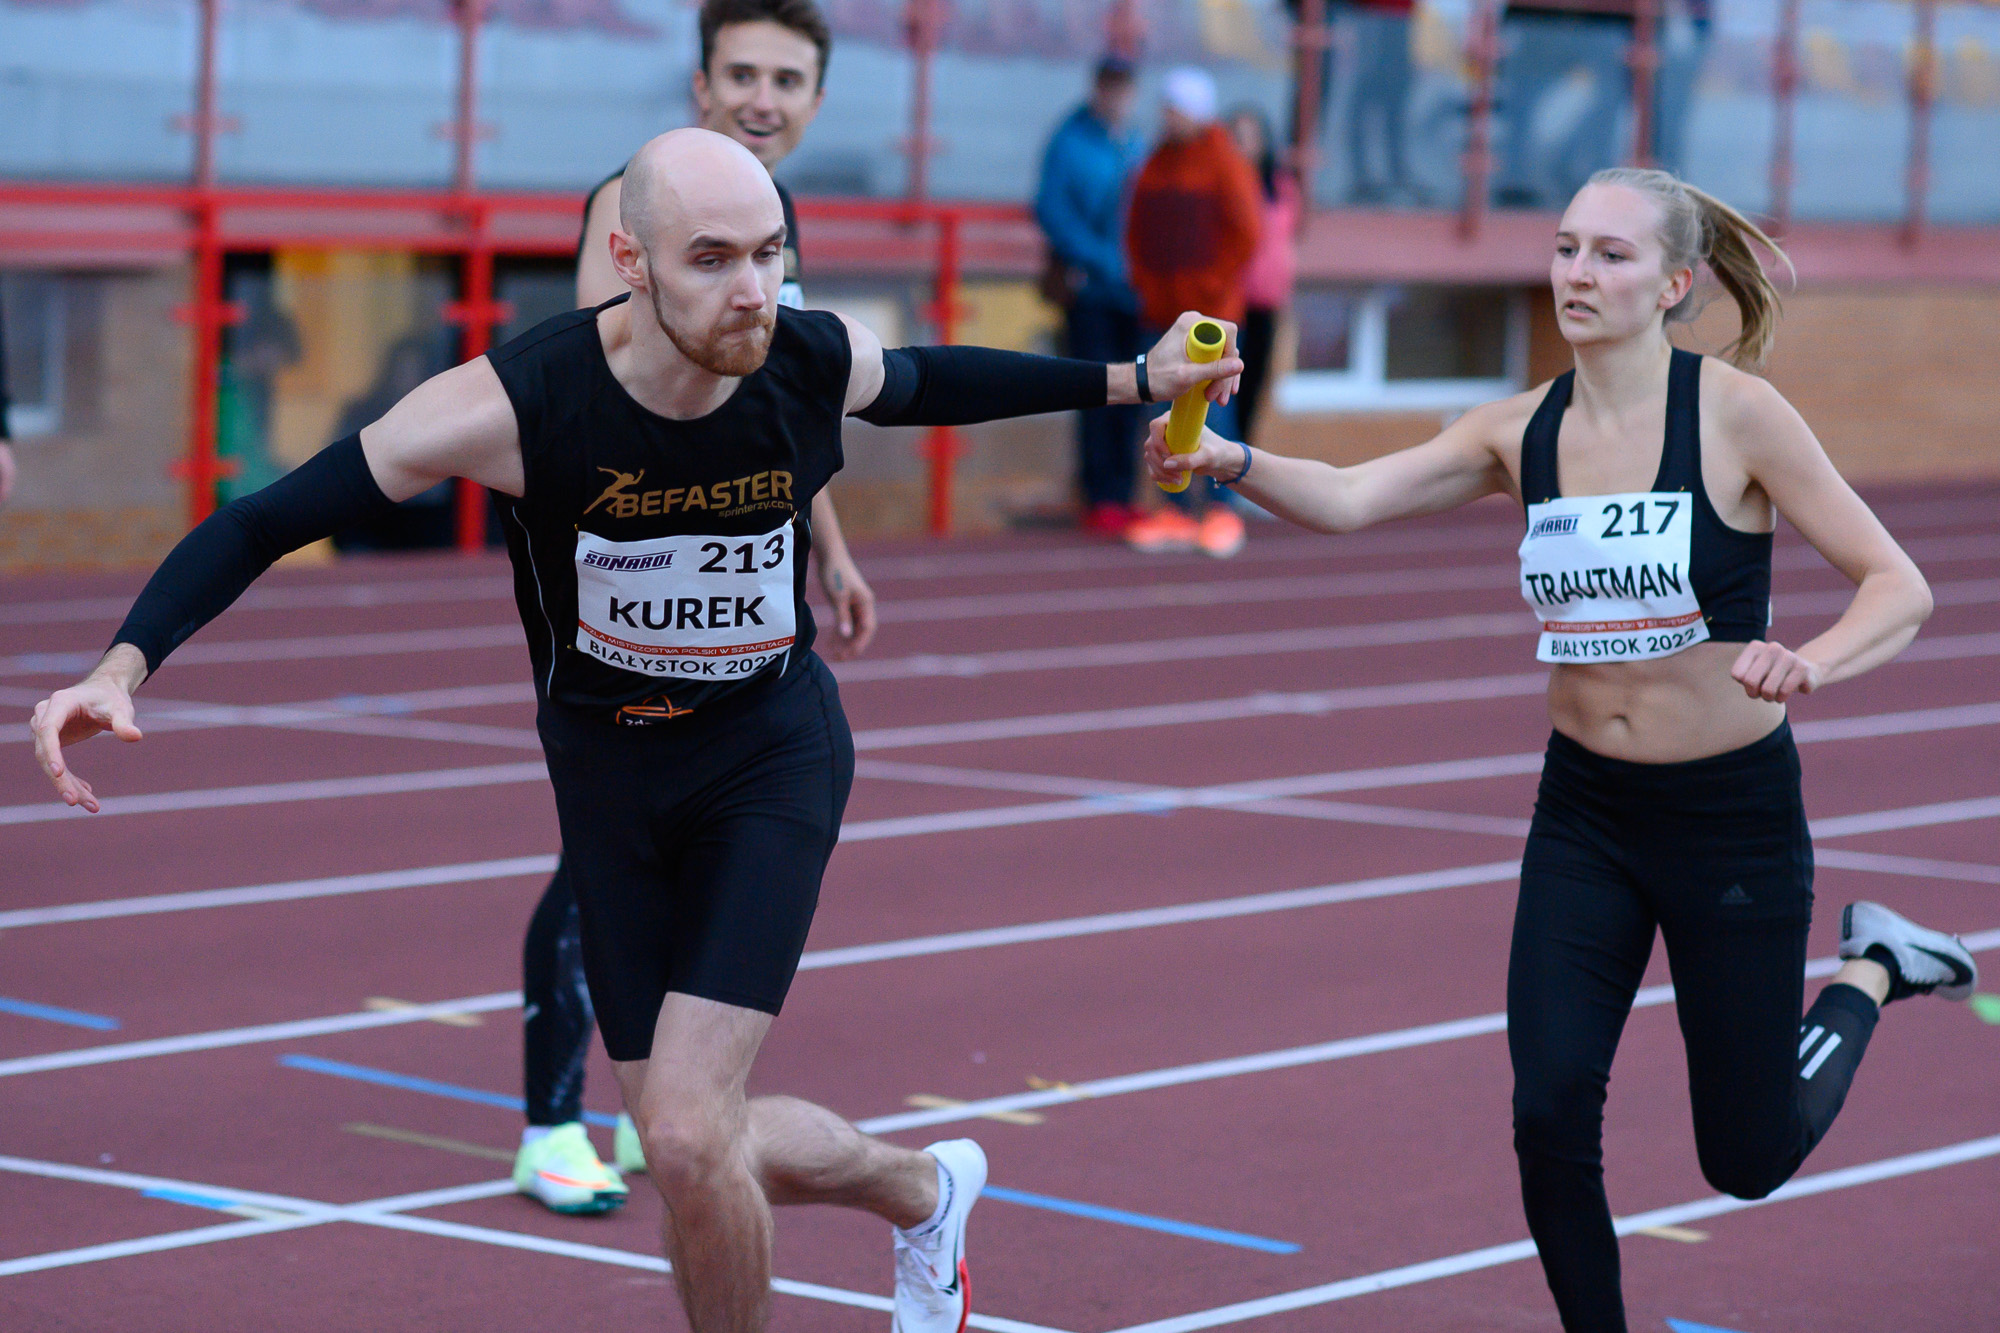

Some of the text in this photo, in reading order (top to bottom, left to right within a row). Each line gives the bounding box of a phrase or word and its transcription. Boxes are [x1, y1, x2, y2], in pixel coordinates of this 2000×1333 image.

[616, 470, 793, 518] BEFASTER
[1601, 500, 1680, 539] 217
[583, 552, 675, 571] SONAROL
[698, 533, 785, 574] 213
[1525, 562, 1683, 606] TRAUTMAN
[609, 595, 766, 630] KUREK
[590, 639, 717, 676] BIAŁYSTOK
[608, 637, 679, 654] MISTRZOSTWA
[731, 638, 790, 654] SZTAFETACH
[1551, 627, 1697, 656] BIAŁYSTOK 2022
